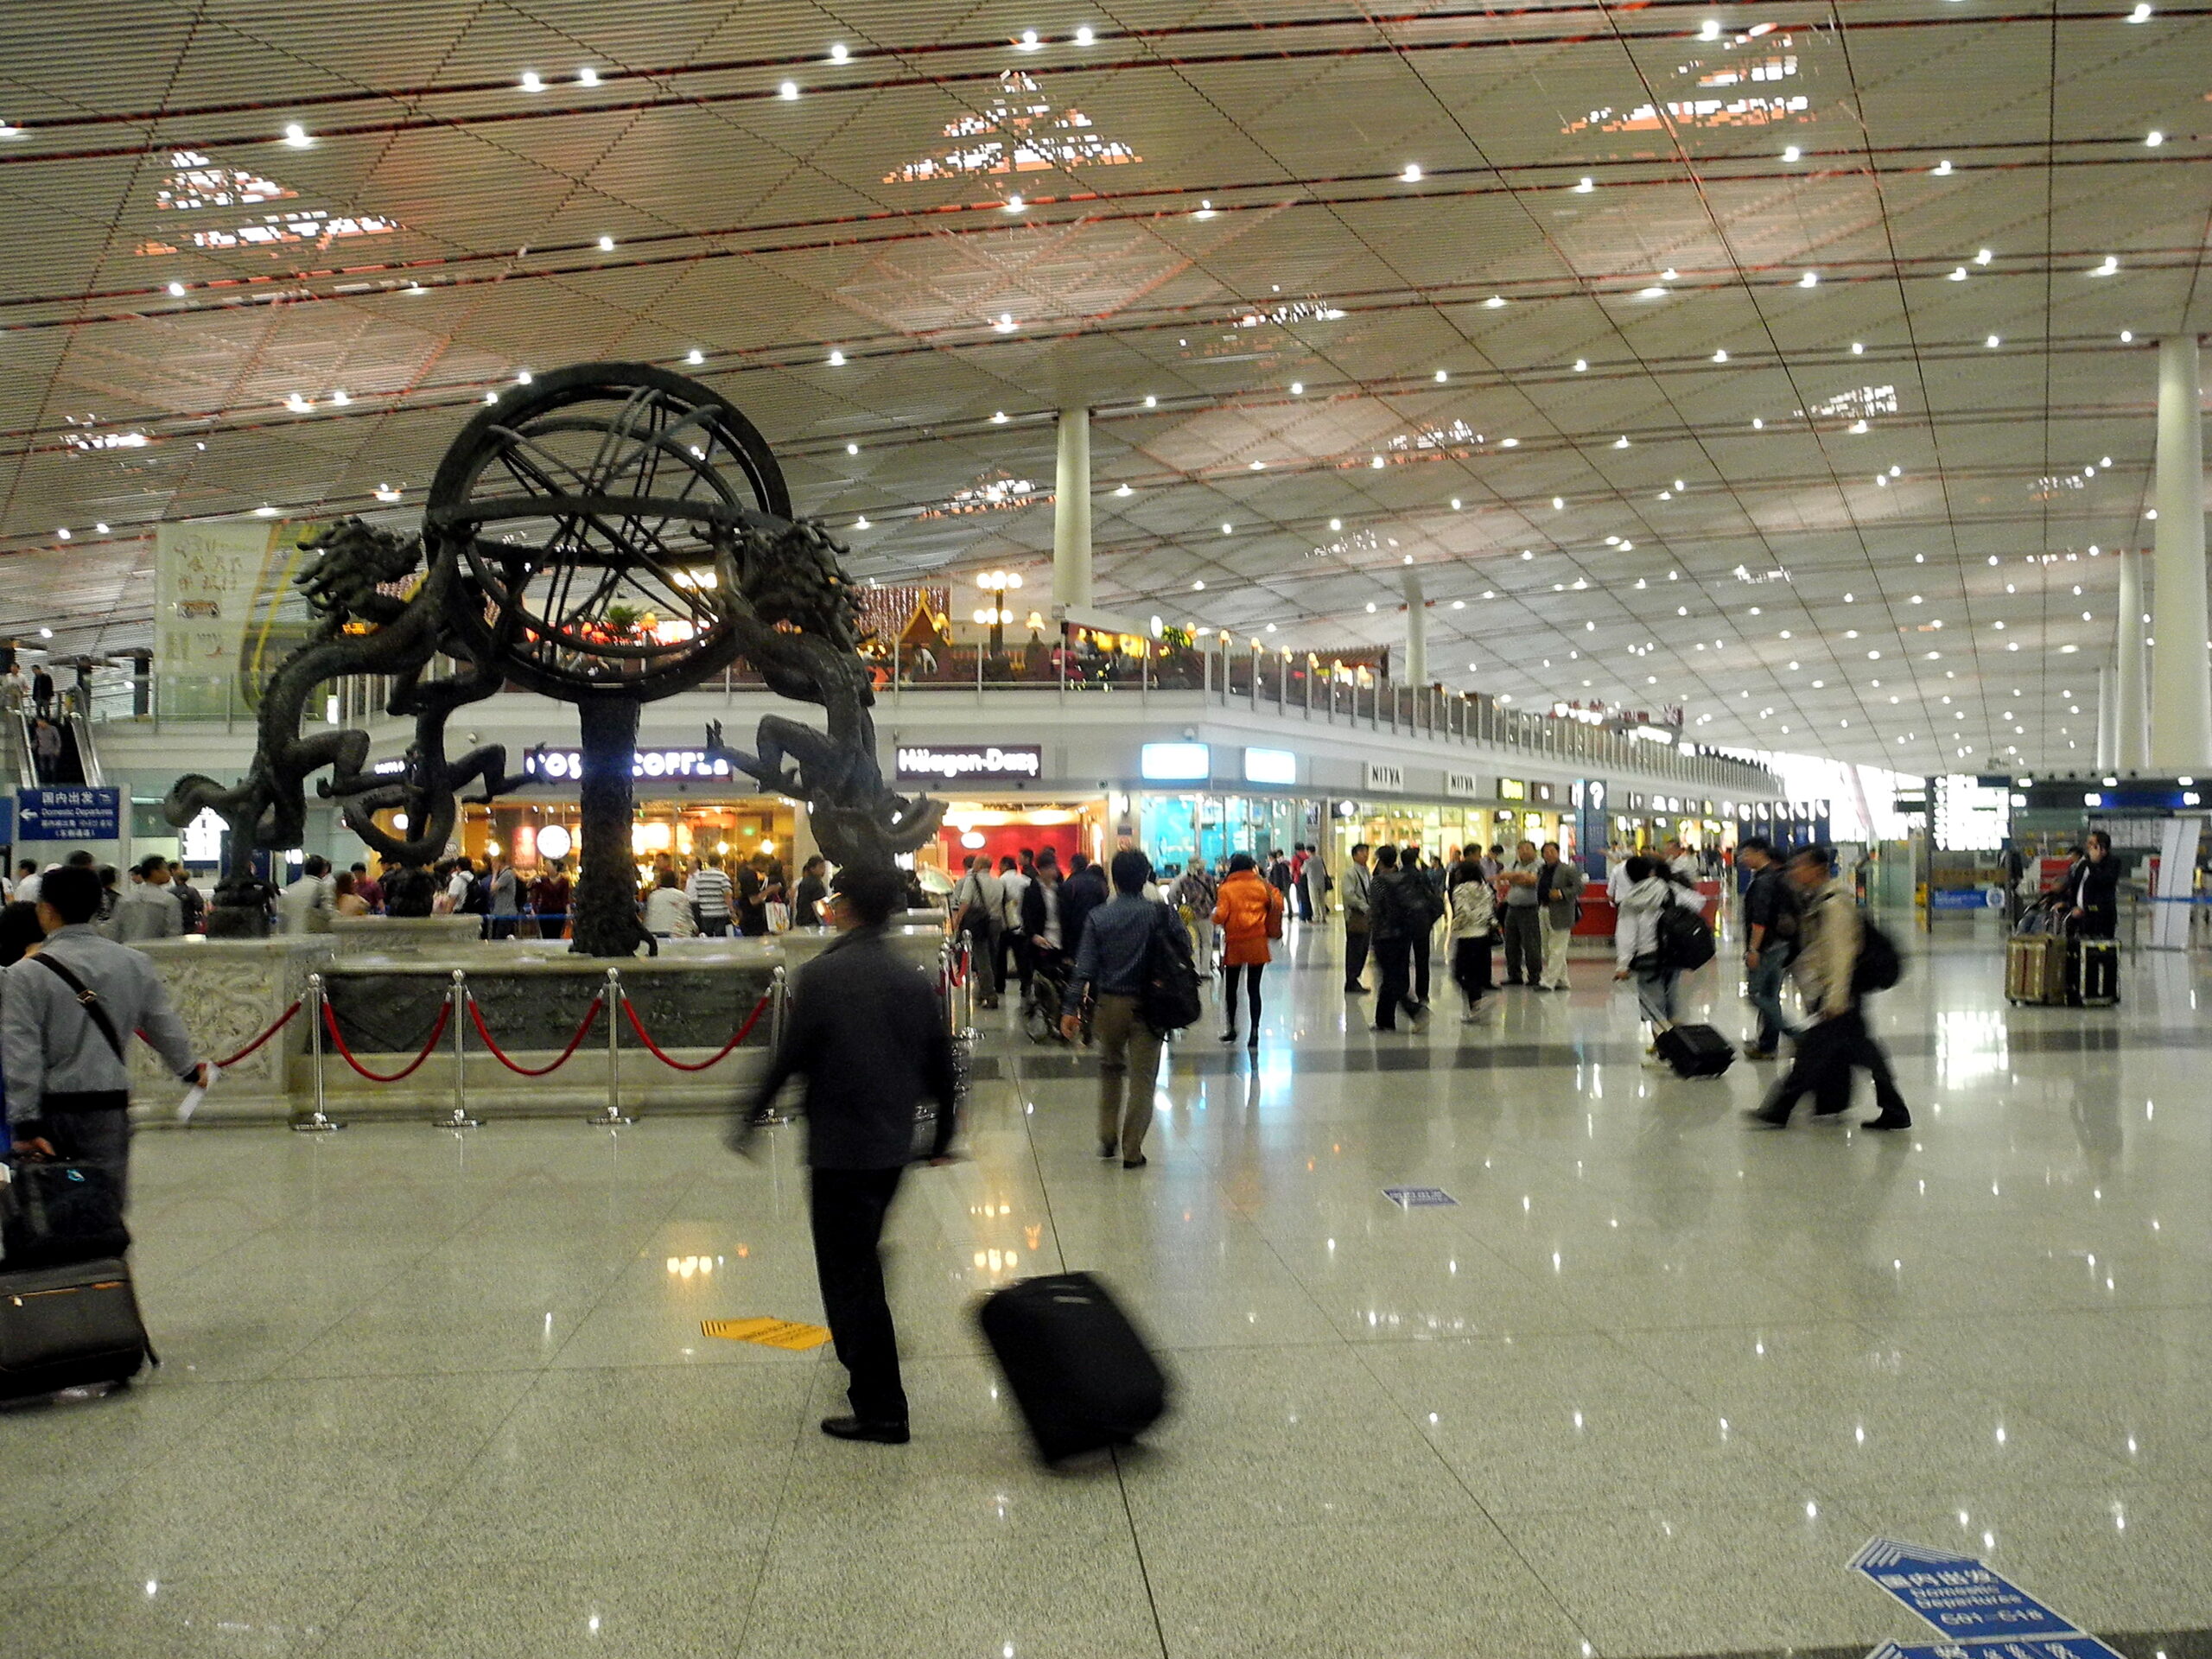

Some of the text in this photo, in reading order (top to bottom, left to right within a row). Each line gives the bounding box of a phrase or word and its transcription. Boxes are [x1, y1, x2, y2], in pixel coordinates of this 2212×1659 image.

[41, 791, 94, 804] 国内出发
[41, 807, 113, 817] Domestic Departures
